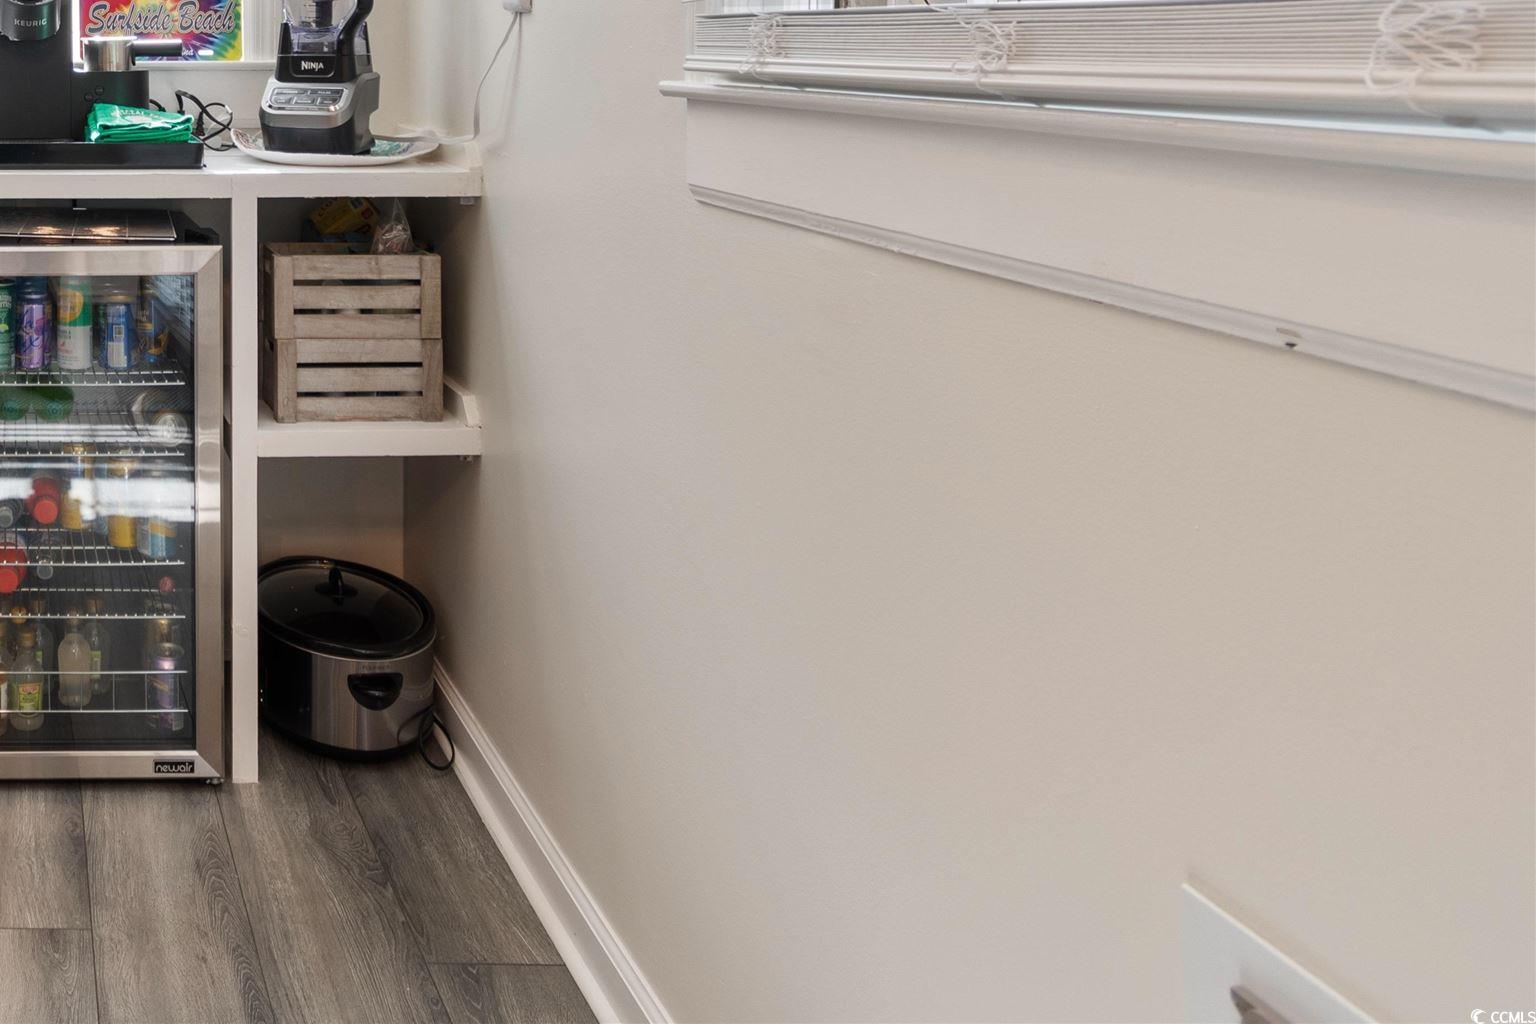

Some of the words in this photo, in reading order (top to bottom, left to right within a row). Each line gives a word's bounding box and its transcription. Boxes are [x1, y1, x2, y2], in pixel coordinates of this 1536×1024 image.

[14, 18, 48, 27] KEURIG
[86, 0, 172, 37] Surfside
[300, 60, 325, 72] NINJA
[154, 762, 194, 774] newair
